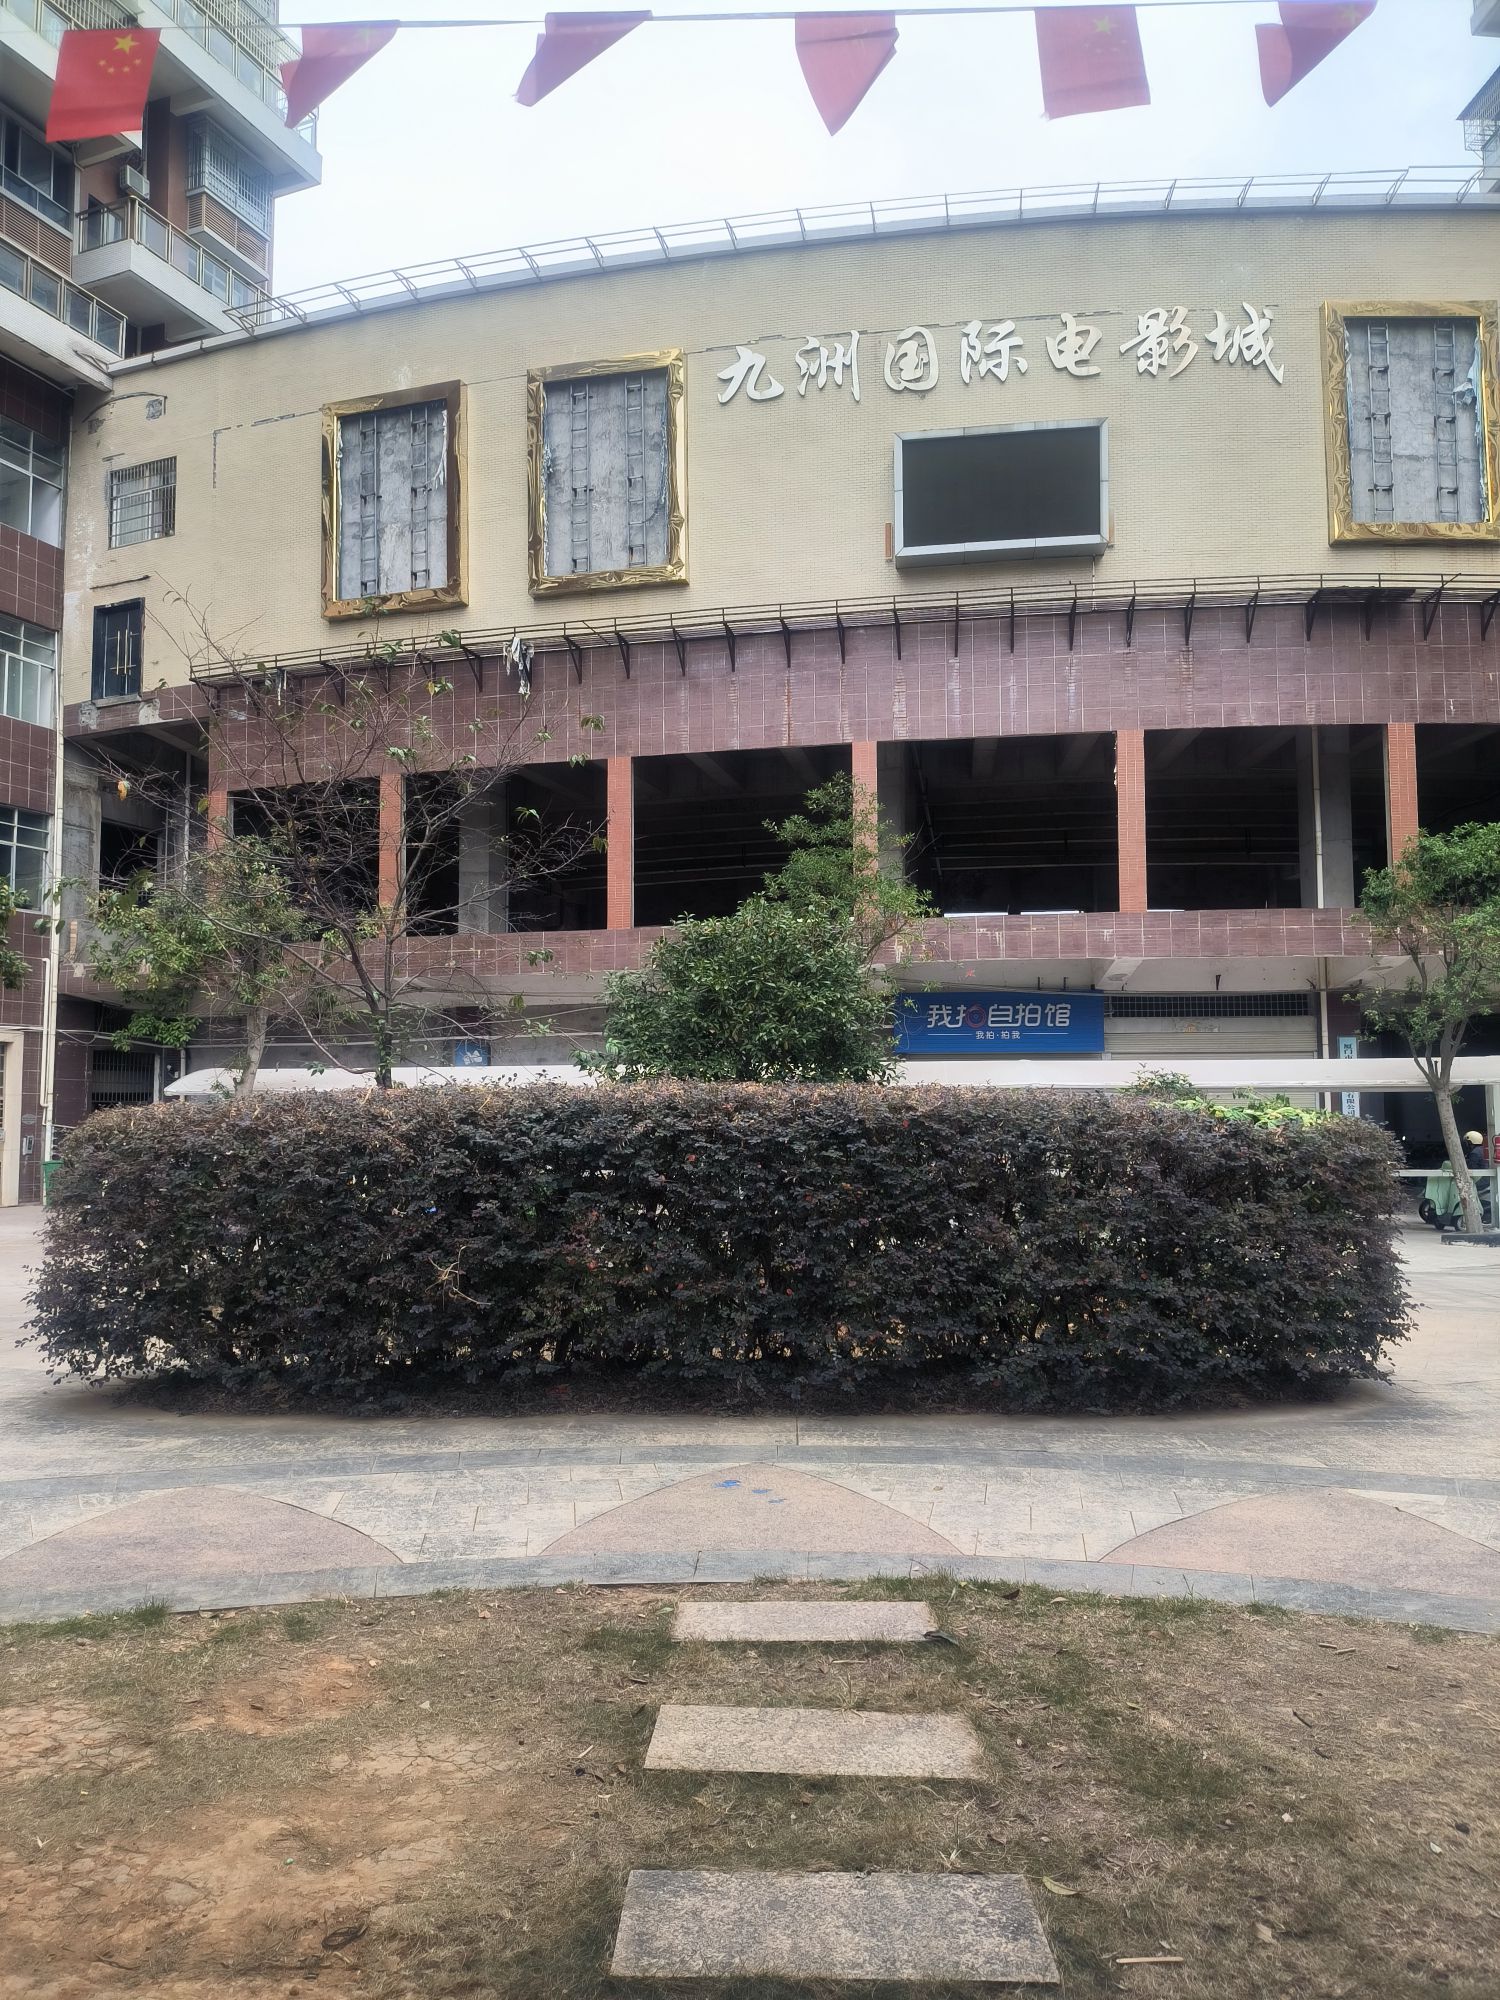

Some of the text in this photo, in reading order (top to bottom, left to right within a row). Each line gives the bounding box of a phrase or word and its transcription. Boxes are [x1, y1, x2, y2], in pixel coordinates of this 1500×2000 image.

[717, 302, 1285, 403] 九洲国际电影城
